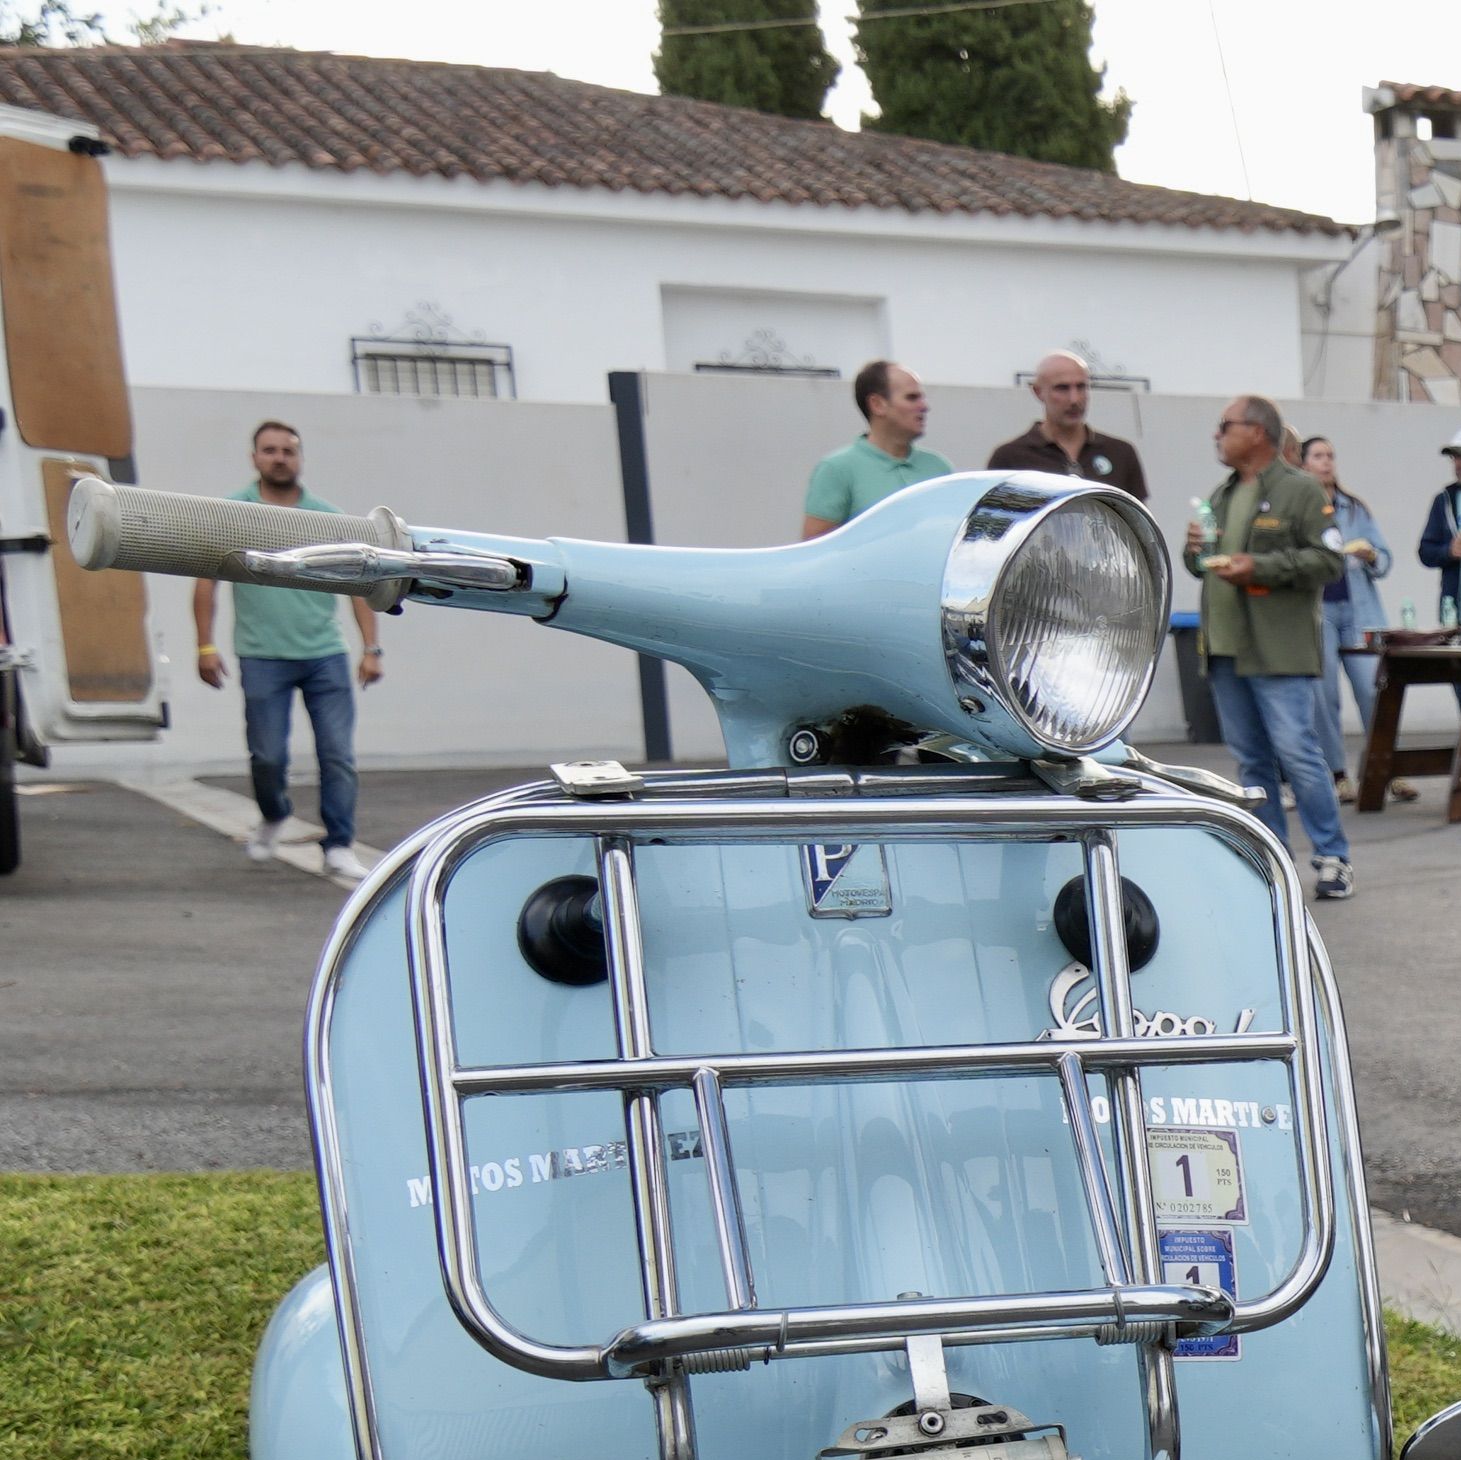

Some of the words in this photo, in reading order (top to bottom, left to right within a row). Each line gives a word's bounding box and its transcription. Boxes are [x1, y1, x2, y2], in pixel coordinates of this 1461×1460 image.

[1175, 1154, 1194, 1197] 1
[1216, 1168, 1231, 1177] 150
[1217, 1178, 1232, 1186] PTS
